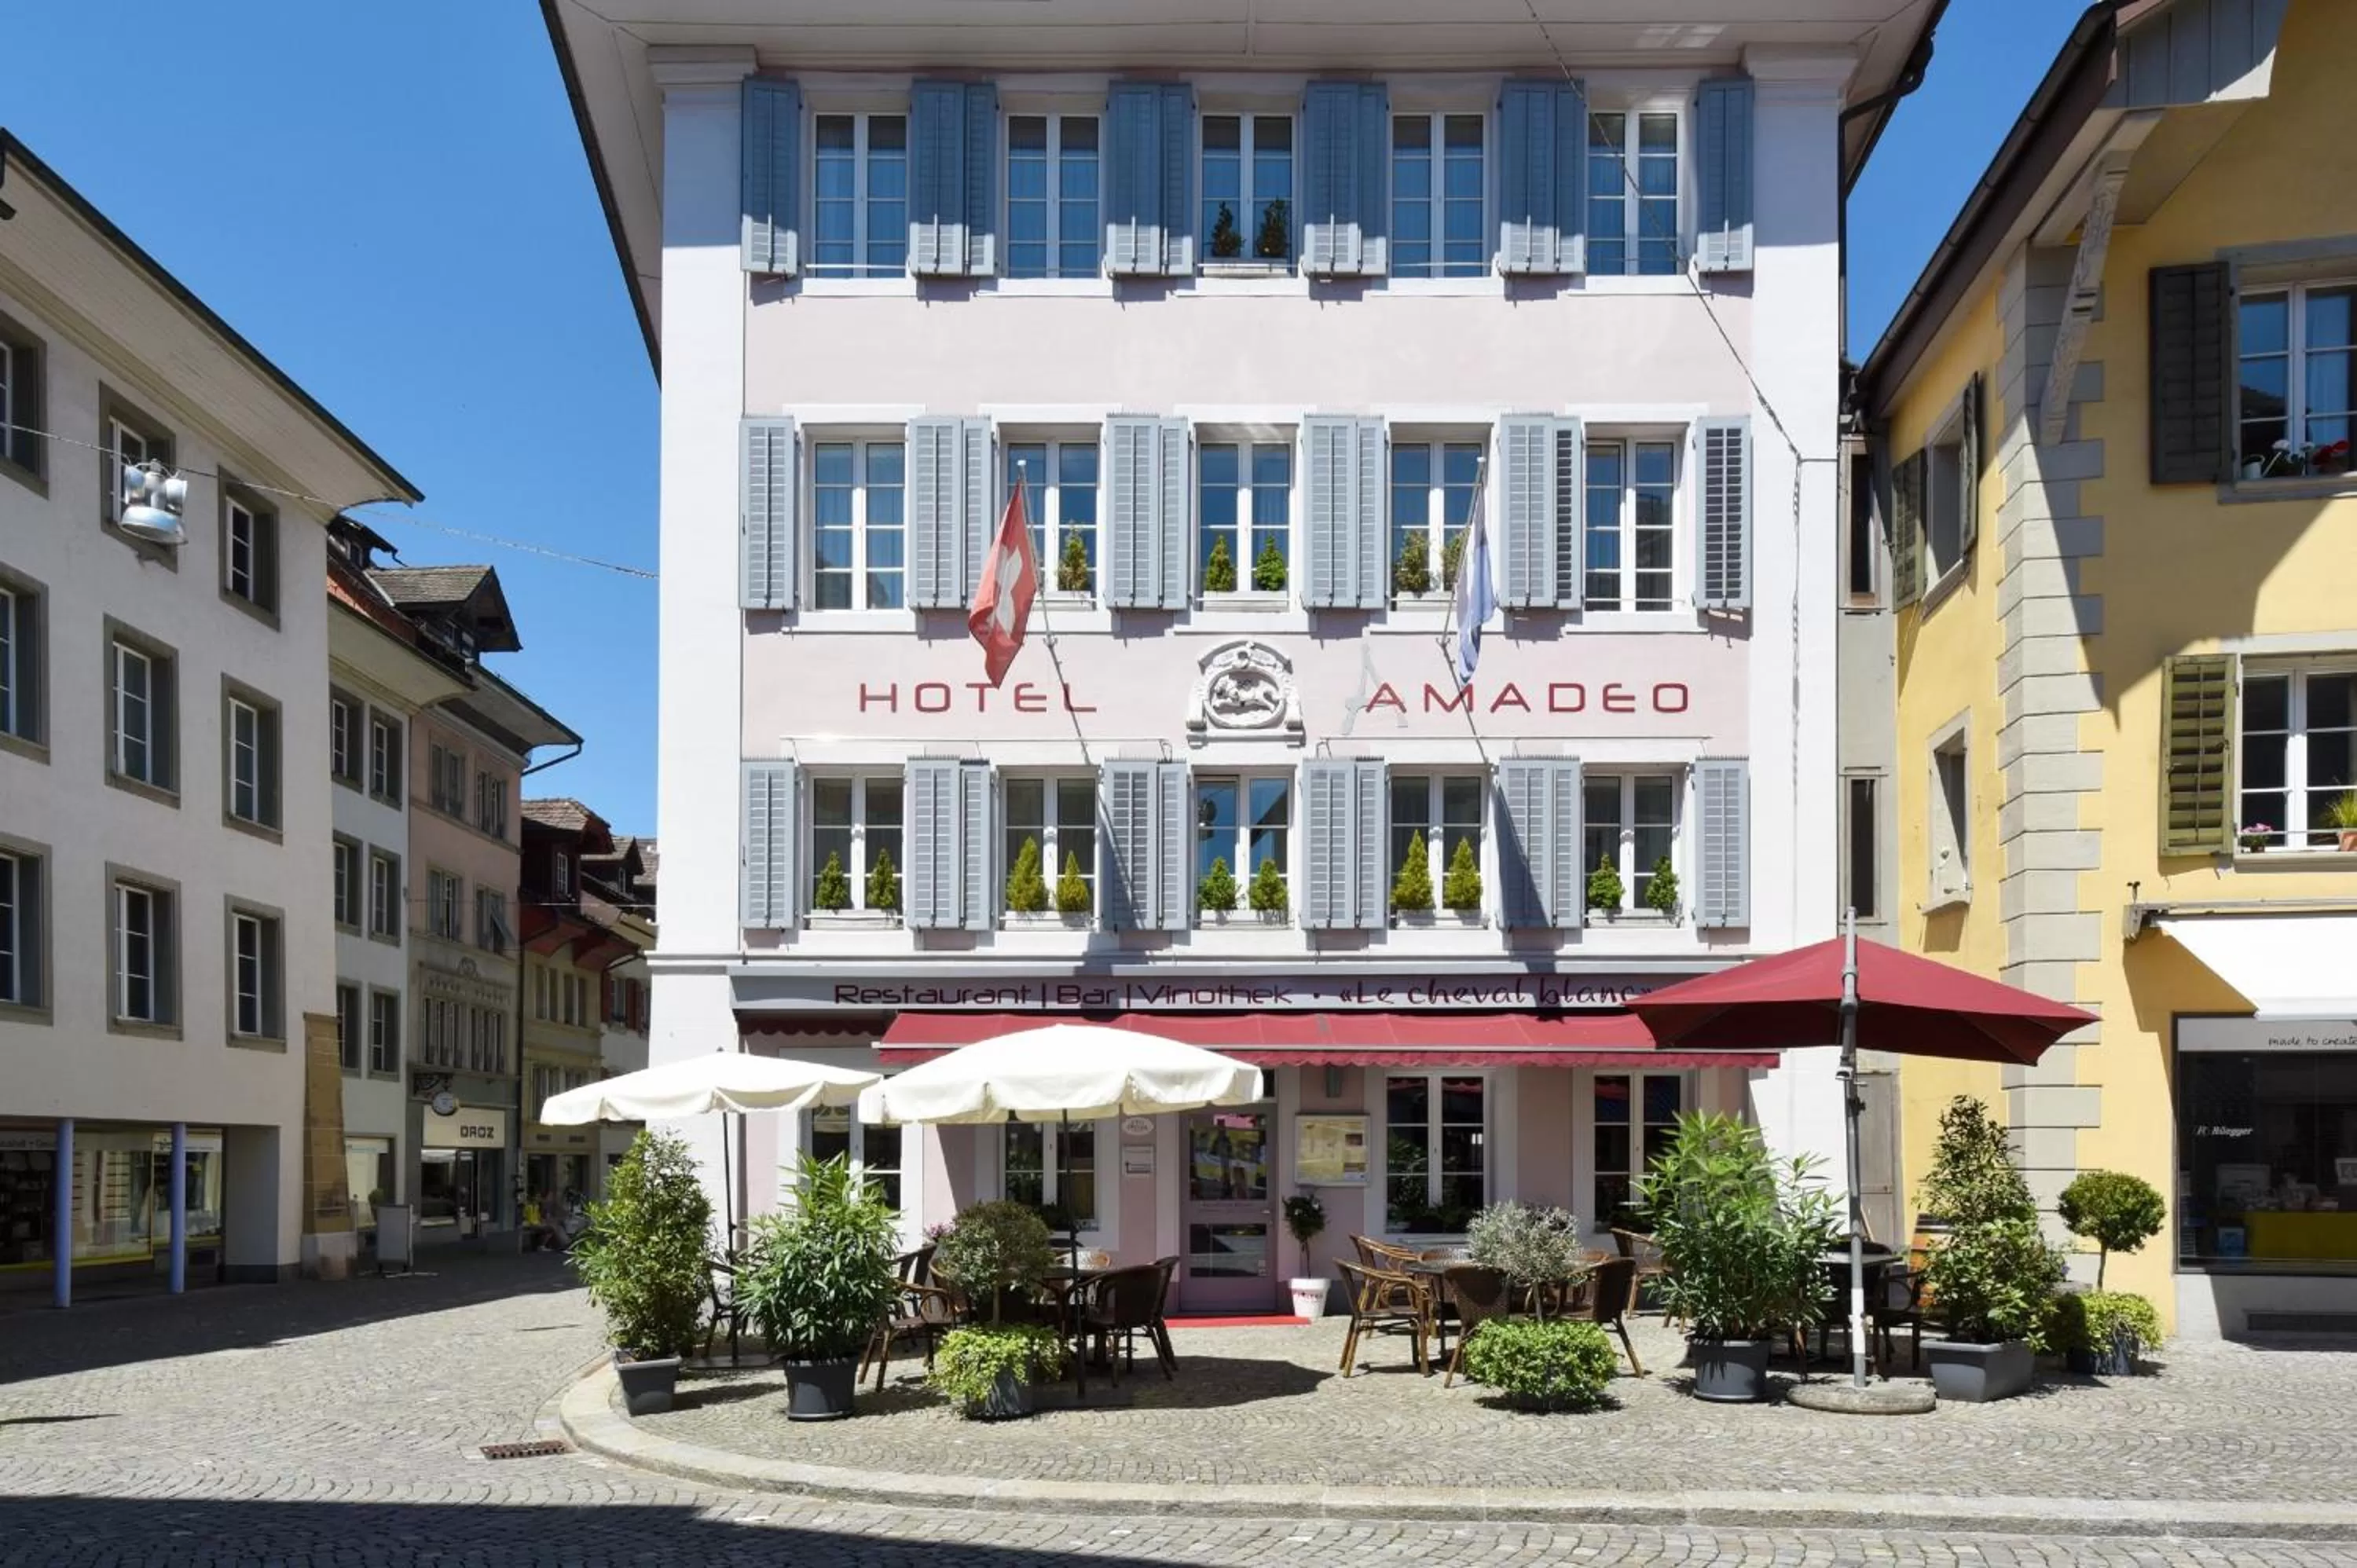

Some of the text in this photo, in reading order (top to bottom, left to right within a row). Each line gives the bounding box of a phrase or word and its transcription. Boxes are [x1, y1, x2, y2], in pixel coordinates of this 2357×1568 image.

[860, 682, 1688, 713] HOTEL AMADEO
[834, 984, 1032, 1006] Restaurant
[1056, 984, 1116, 1006] Bar
[1137, 984, 1293, 1005] Vinothek
[1406, 976, 1525, 1005] cheval
[2267, 1035, 2301, 1047] made
[2307, 1035, 2319, 1046] to
[460, 1125, 495, 1139] DROZ
